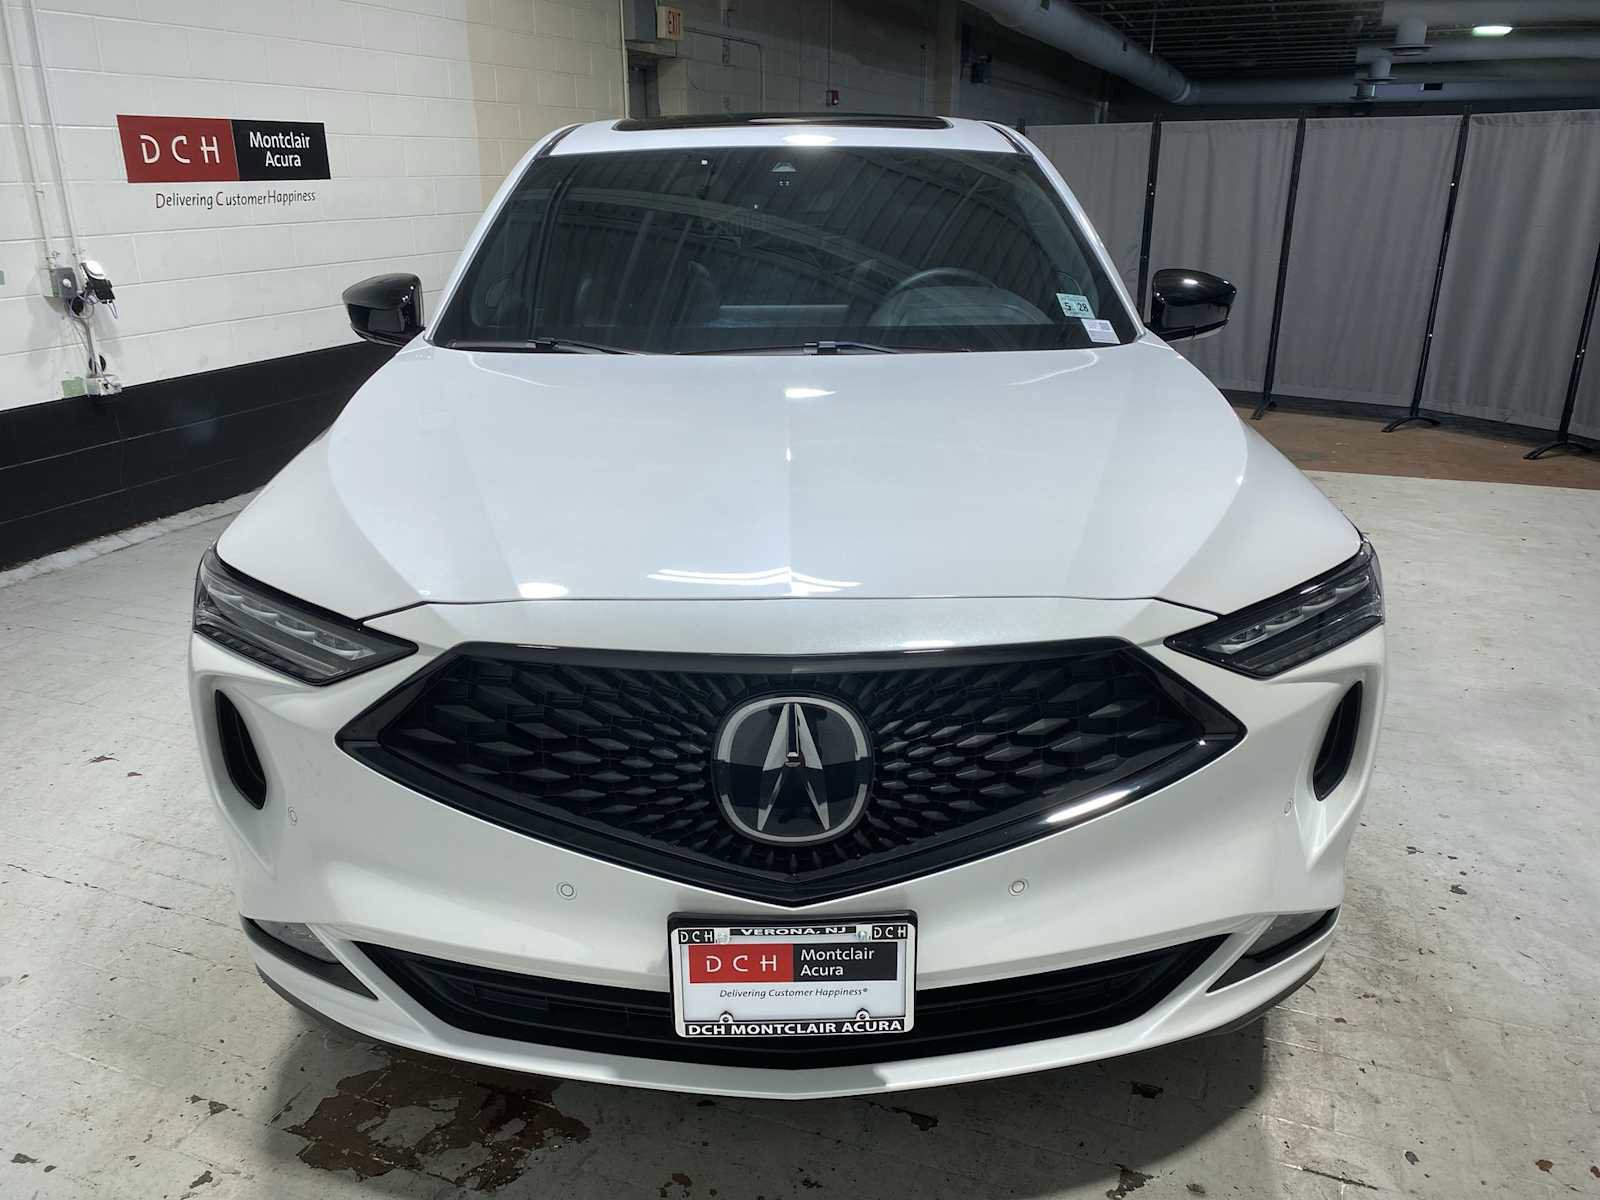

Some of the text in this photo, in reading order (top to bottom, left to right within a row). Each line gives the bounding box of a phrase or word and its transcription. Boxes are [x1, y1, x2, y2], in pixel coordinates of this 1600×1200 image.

[249, 131, 311, 150] Montclair
[265, 152, 302, 168] Acura
[155, 189, 316, 210] Delivering Customer Happiness
[740, 926, 847, 935] VERONA, NJ
[800, 947, 875, 961] Montclair
[800, 964, 844, 977] Acura
[719, 989, 766, 999] Delivering
[768, 988, 813, 997] Customer
[688, 1020, 902, 1036] DCH MONTCLAIR ACURA
